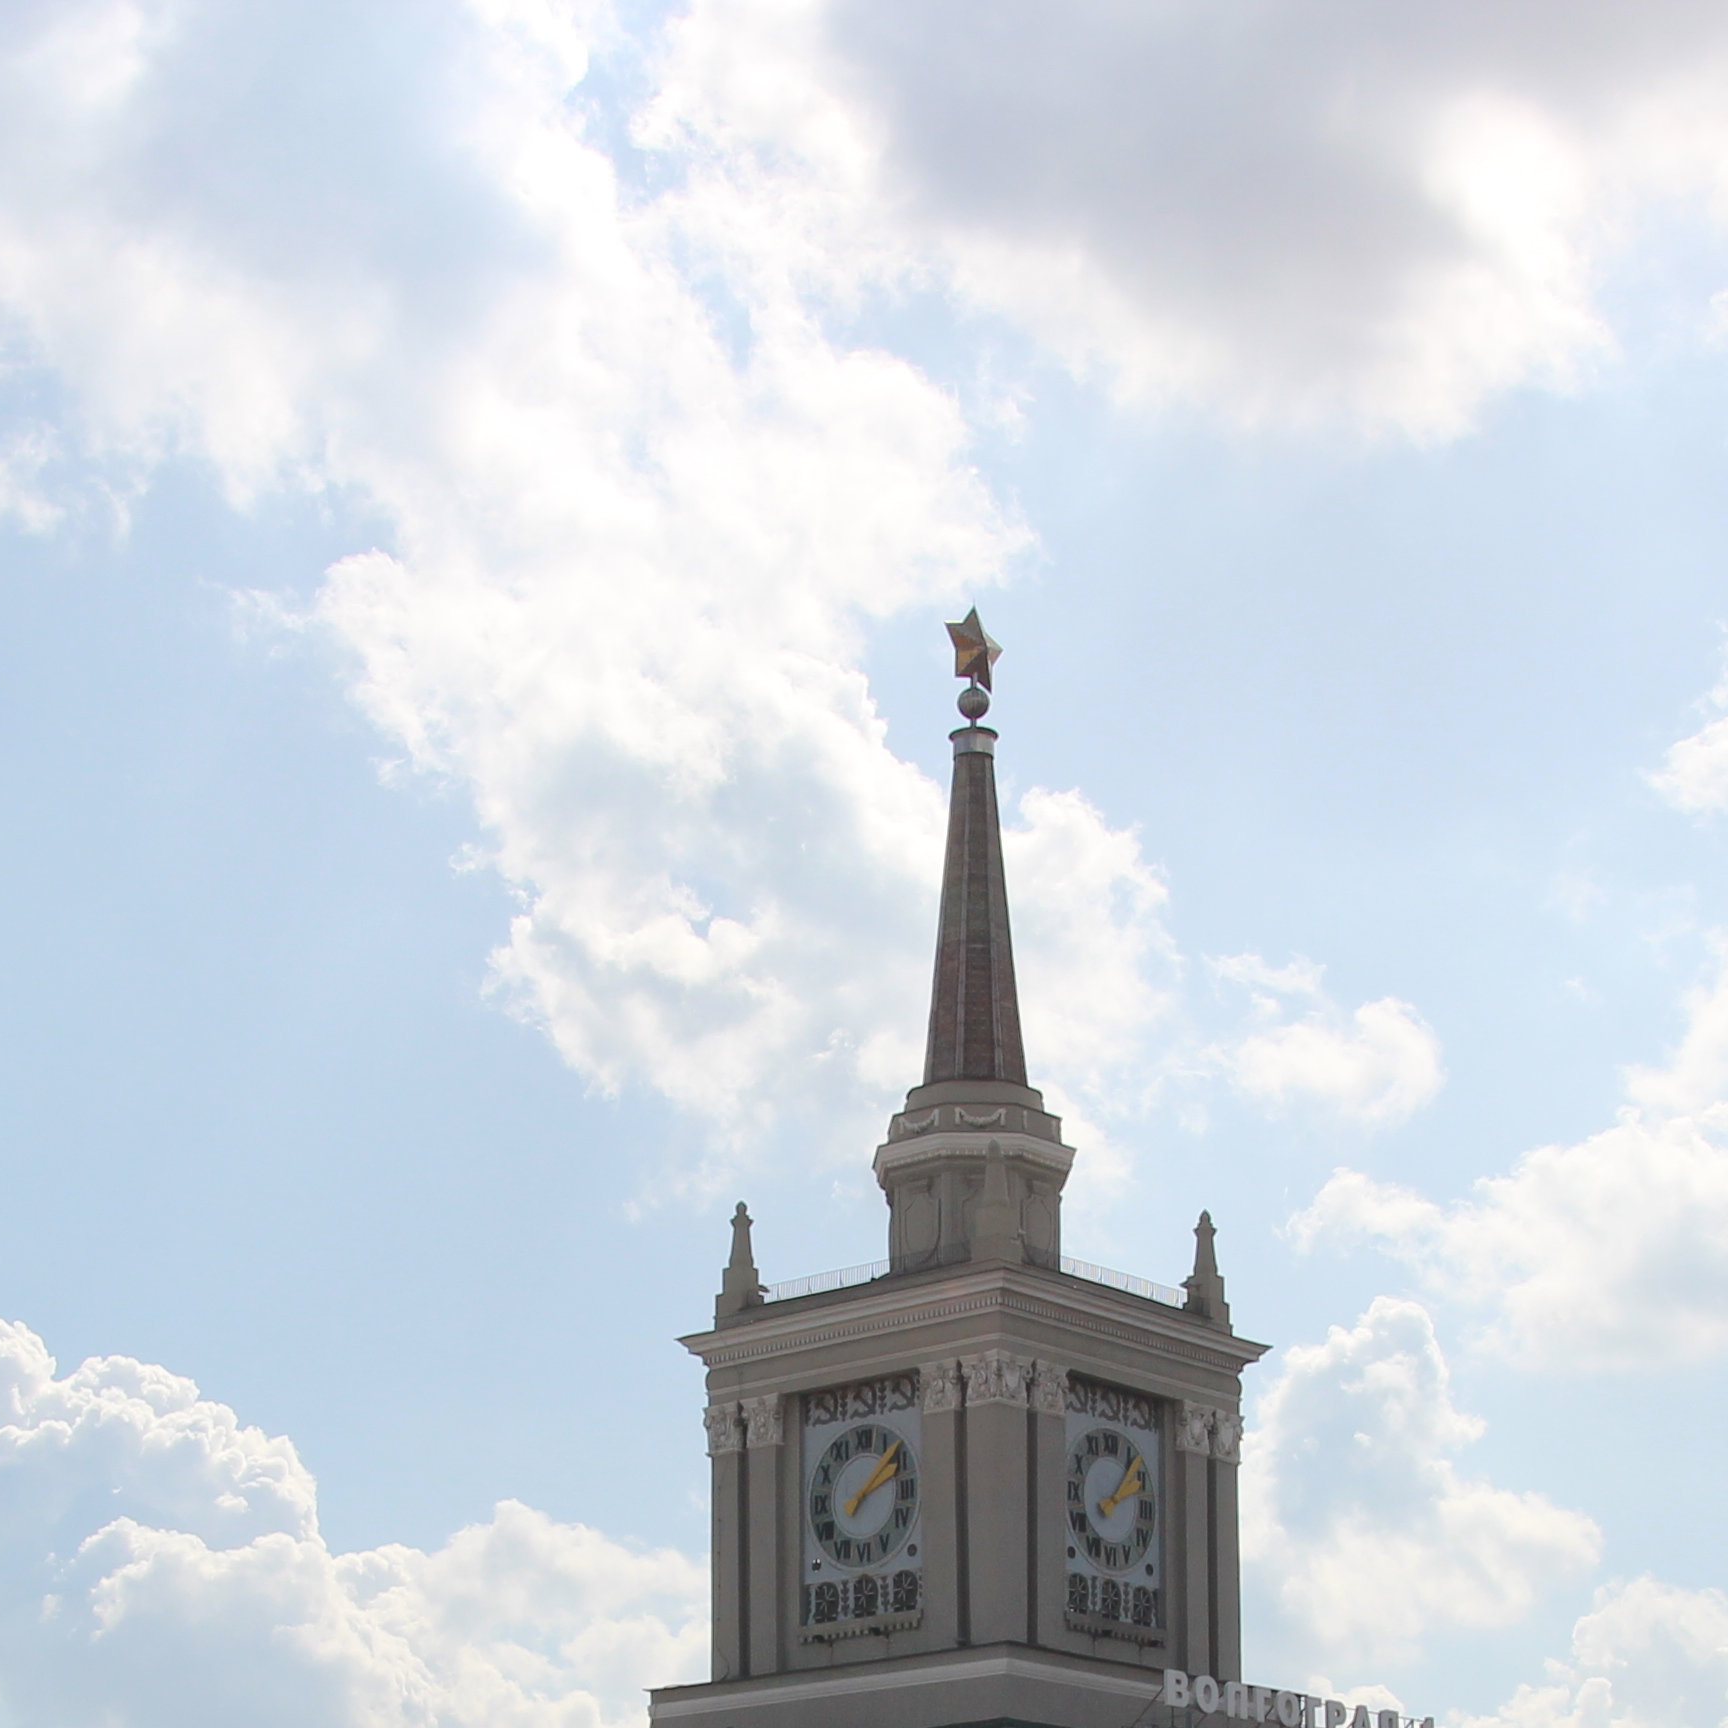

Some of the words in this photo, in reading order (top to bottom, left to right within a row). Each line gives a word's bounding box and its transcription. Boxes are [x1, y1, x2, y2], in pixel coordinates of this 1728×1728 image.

[1086, 1435, 1099, 1456] XI
[821, 1464, 831, 1485] X
[1075, 1454, 1083, 1475] X
[900, 1478, 914, 1500] III
[1067, 1481, 1080, 1502] IX
[814, 1495, 828, 1515] IX
[1140, 1500, 1152, 1521] III
[895, 1508, 910, 1529] IV
[879, 1533, 890, 1554] V
[1136, 1527, 1150, 1547] IV
[857, 1542, 871, 1563] VI
[1104, 1545, 1117, 1566] VI
[1122, 1544, 1131, 1564] V
